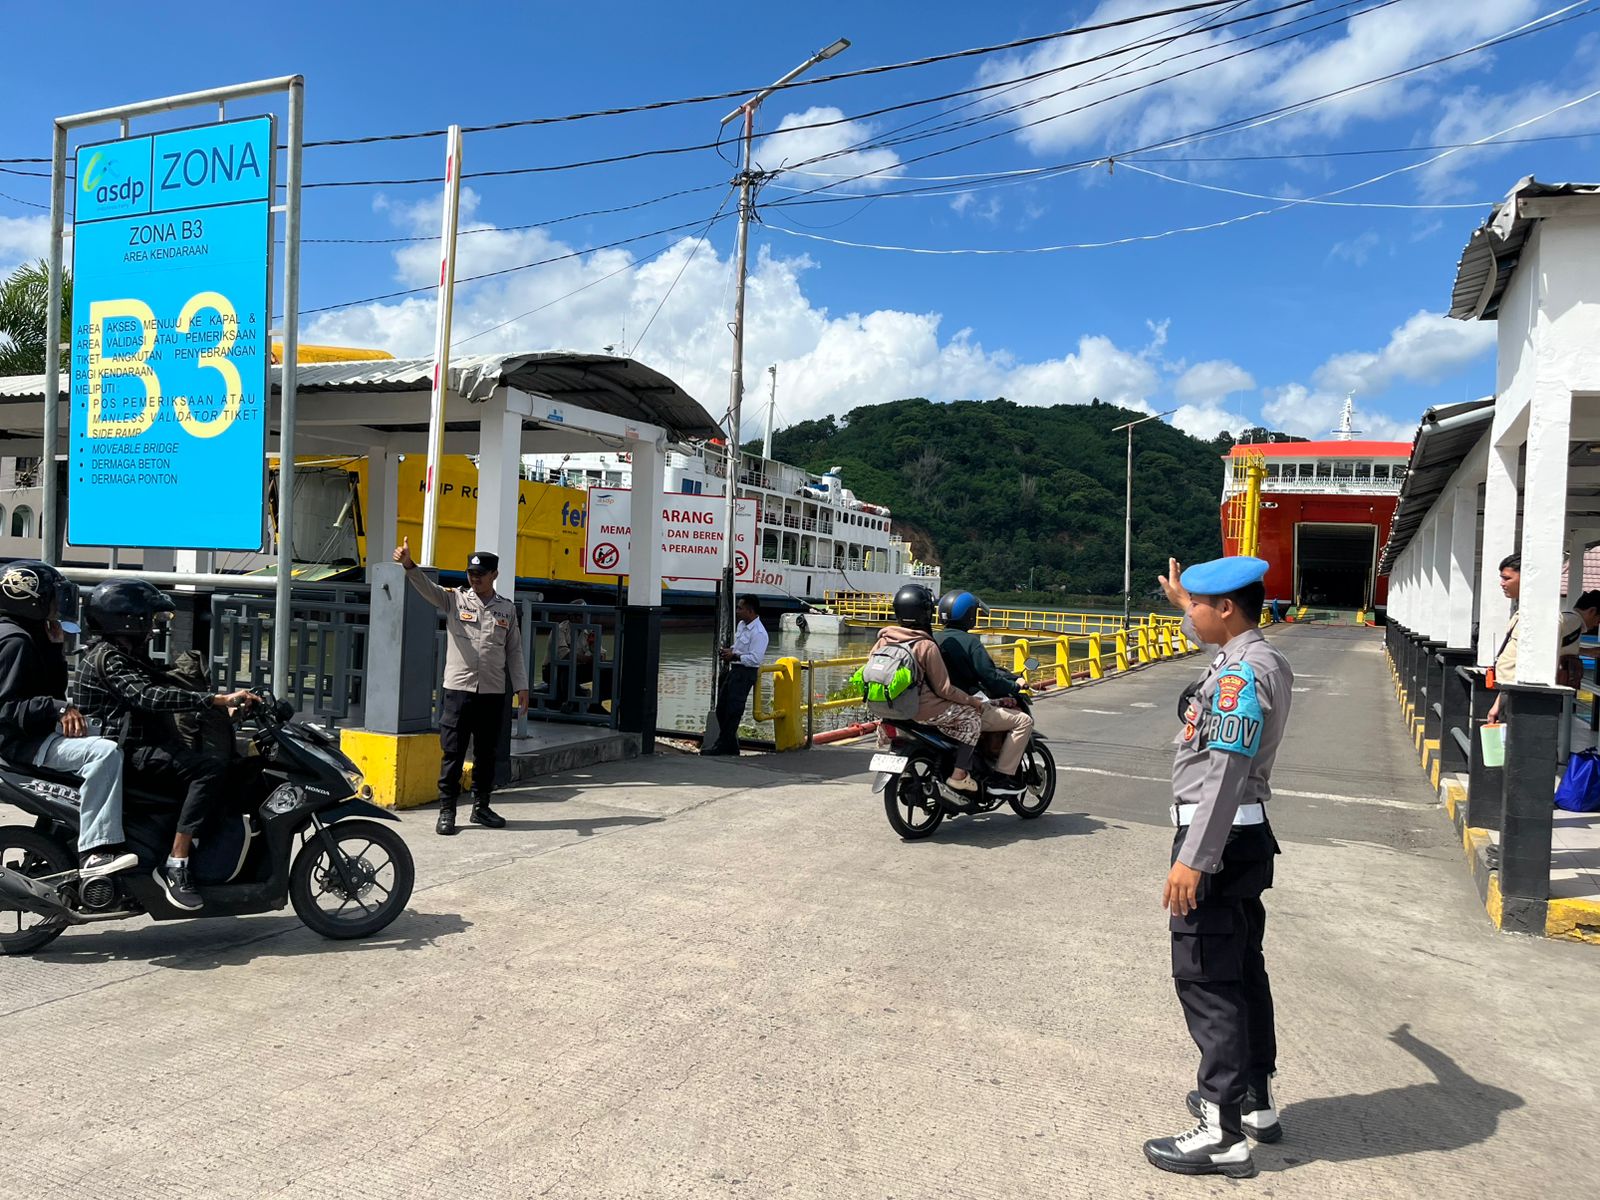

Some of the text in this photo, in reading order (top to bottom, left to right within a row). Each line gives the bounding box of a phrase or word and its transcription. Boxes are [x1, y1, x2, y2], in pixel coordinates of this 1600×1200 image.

[161, 142, 260, 190] ZONA
[96, 176, 144, 204] asdp
[129, 219, 204, 245] ZONA B3
[123, 244, 208, 263] AREA KENDARAAN
[77, 313, 256, 335] AREA AKSES MENUJU KE KAPAL &
[76, 329, 256, 350] AREA VALIDASI ATAU PEMERIKSAAN
[76, 345, 256, 365] TIKET ANGKUTAN PENYEBRANGAN
[88, 291, 242, 438] B3
[75, 366, 154, 380] BAGI KENDARAAN
[75, 384, 116, 395] MELIPUTI
[93, 393, 255, 409] POS PEMERIKSAAN ATAU
[92, 409, 259, 424] MANLESS VALIDATOR TIKET
[92, 427, 142, 439] SIDE RAMP
[92, 442, 180, 454] MOVEABLE BRIDGE
[91, 458, 170, 469] DERMAGA BETON
[91, 473, 178, 485] DERMAGA PONTON
[419, 479, 454, 495] KP
[662, 509, 714, 525] ARANG
[667, 529, 745, 542] DAN BERENG
[669, 544, 718, 555] PERAIRAN
[755, 568, 783, 586] tion
[38, 783, 80, 801] STRE
[305, 785, 330, 796] HONDA
